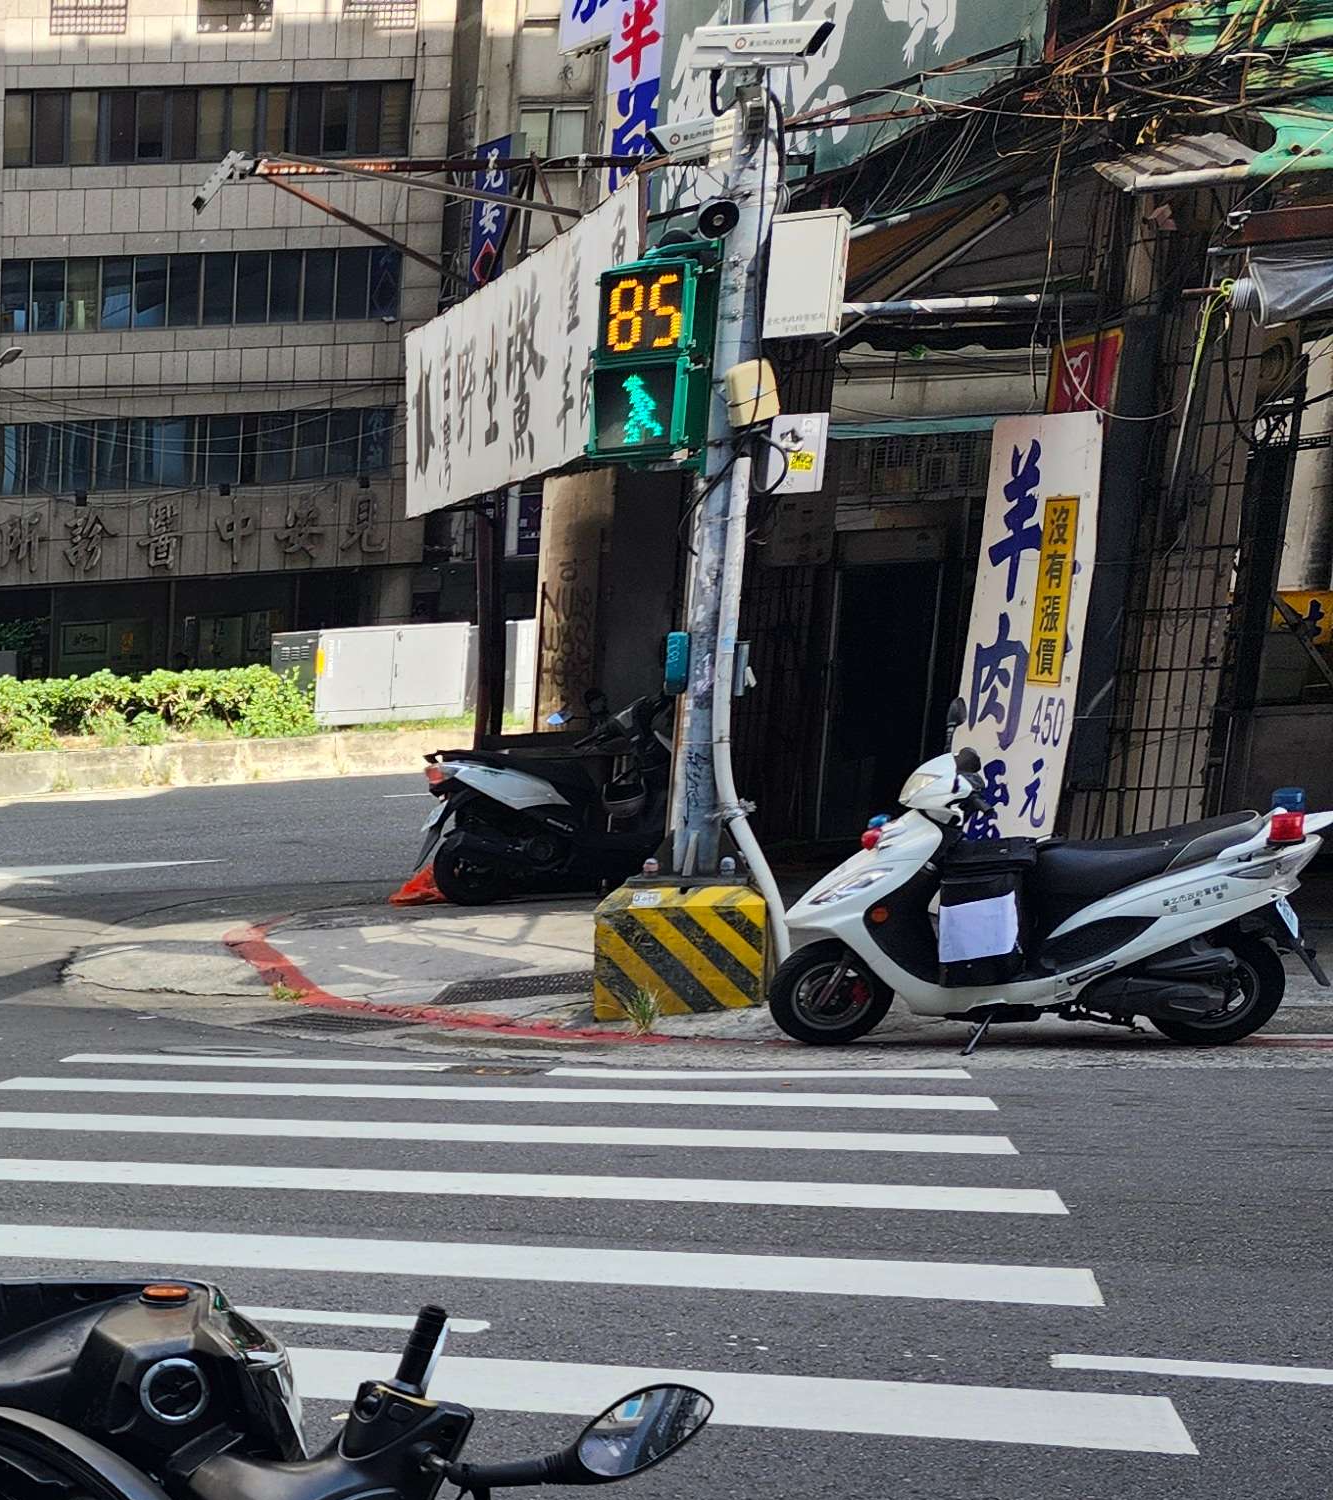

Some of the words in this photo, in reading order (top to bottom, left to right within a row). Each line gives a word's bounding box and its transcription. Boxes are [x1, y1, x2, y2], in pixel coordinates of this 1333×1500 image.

[606, 273, 682, 352] 85
[1035, 505, 1069, 677] 沒有漲價
[1030, 696, 1066, 747] 450
[1019, 758, 1046, 828] 元
